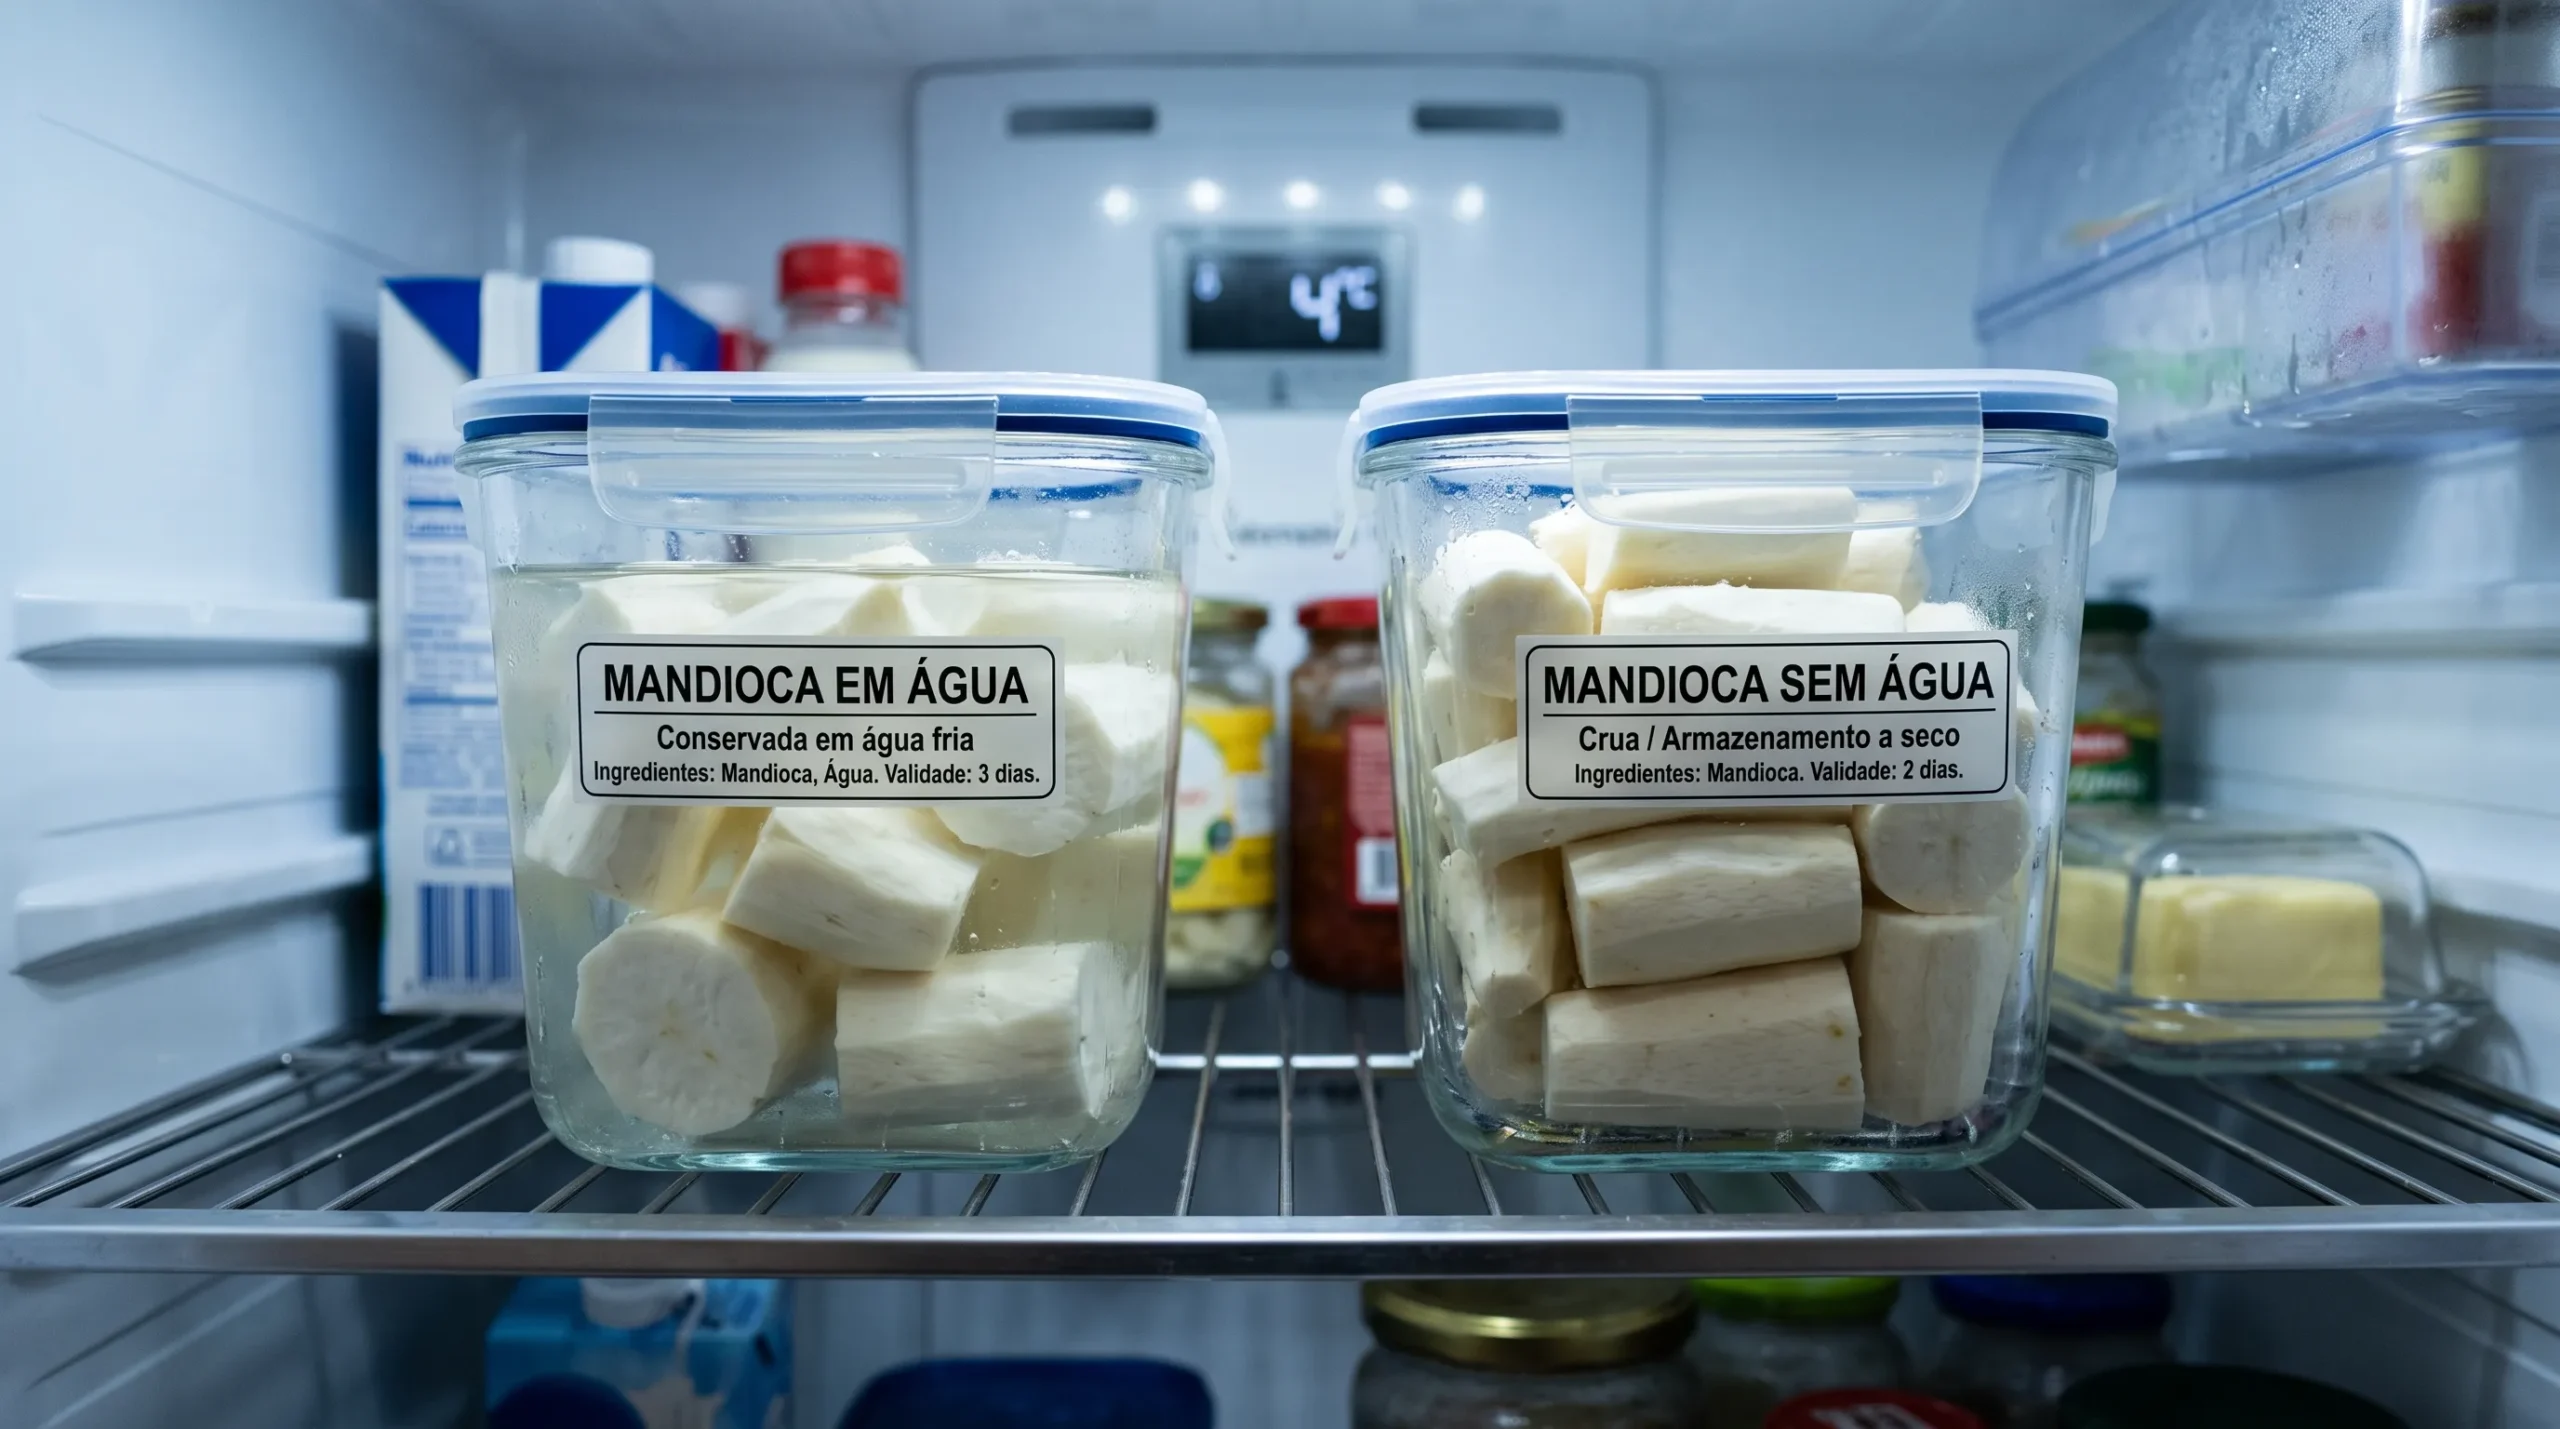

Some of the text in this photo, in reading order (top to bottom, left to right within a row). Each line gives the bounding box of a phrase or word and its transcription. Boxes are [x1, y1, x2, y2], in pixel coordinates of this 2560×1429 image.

[604, 656, 1029, 705] MANDIOCA EM ÁGUA
[1544, 652, 1995, 704] MANDIOCA SEM ÁGUA
[656, 724, 974, 759] Conservada em água fria
[1578, 723, 1961, 752] Crua / Armazenamento a seco
[594, 757, 1040, 789] Ingredientes: Mandioca, Água. Validade: 3 dias.
[1575, 758, 1964, 789] Ingredientes: Mandioca. Validade: 2 dias.
